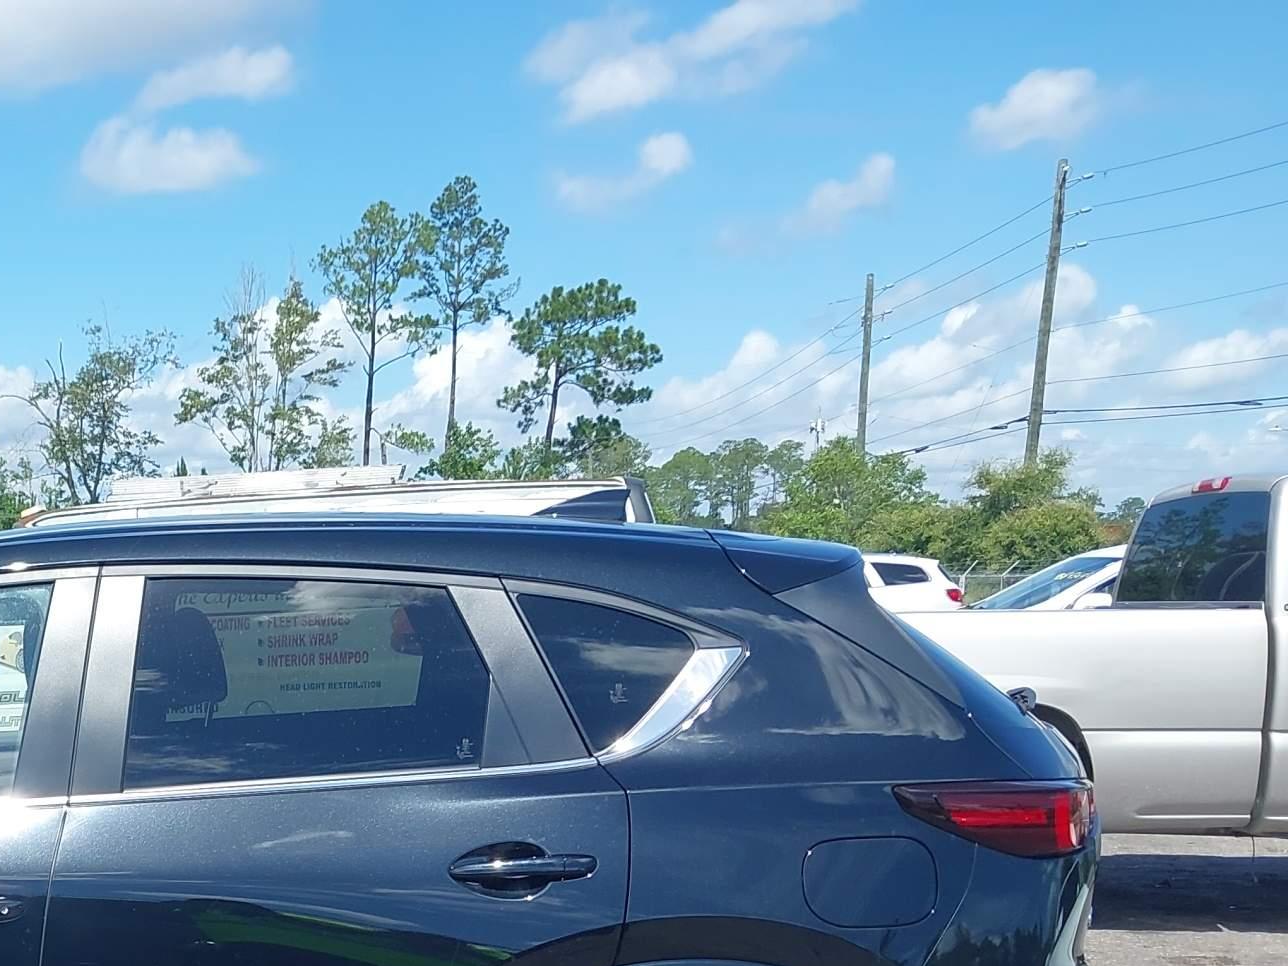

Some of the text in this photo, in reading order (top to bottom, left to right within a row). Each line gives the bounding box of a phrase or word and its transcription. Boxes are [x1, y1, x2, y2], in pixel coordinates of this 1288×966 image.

[267, 632, 338, 649] SHRINK WRAP
[267, 650, 369, 668] INTERIOR SHAMPOO
[280, 683, 301, 691] HEAD
[303, 681, 325, 691] LIGHT
